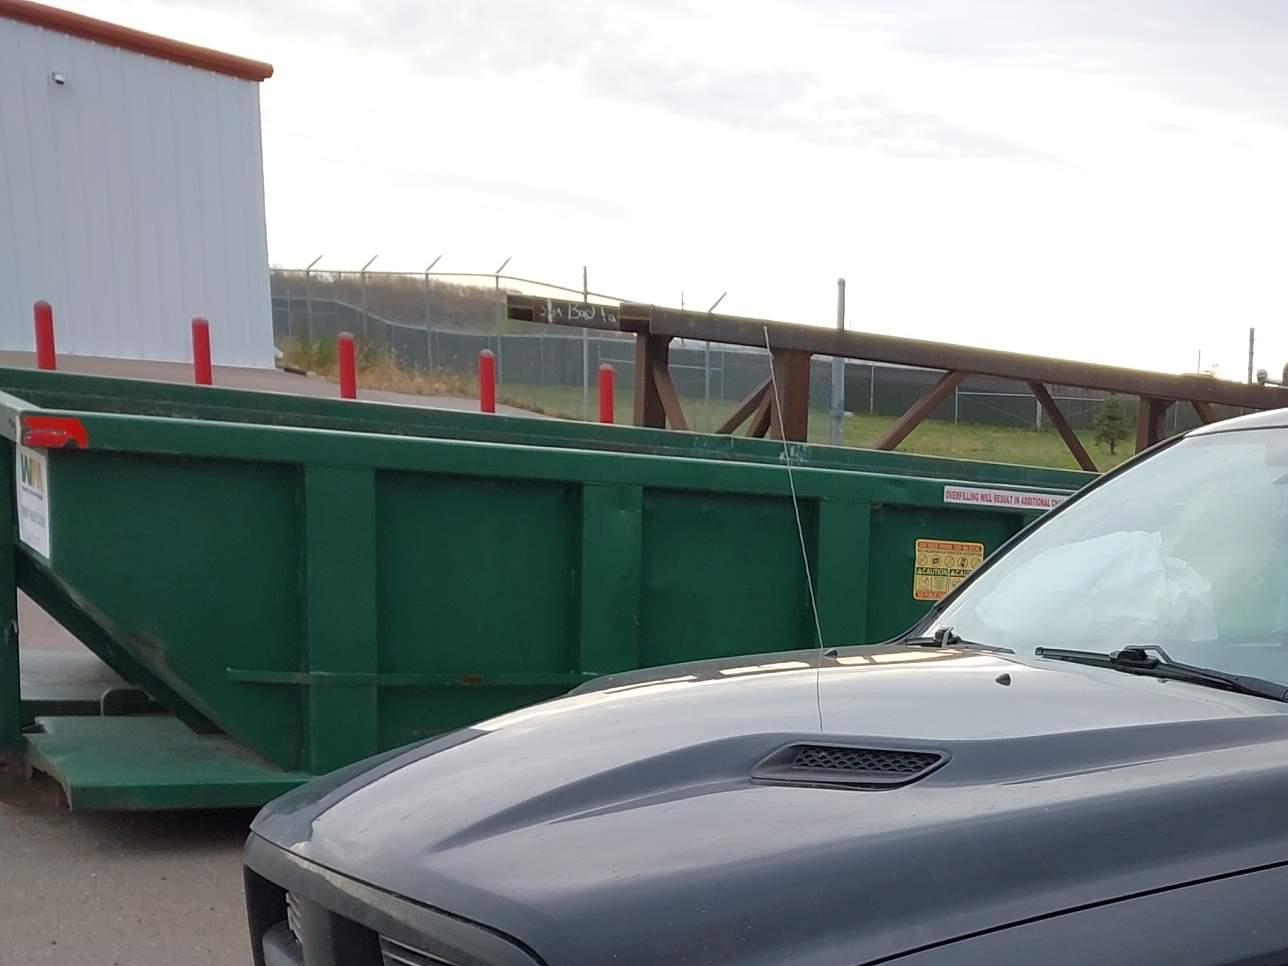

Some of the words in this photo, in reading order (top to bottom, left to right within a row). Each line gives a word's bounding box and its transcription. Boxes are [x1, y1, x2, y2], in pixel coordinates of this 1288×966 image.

[945, 490, 979, 501] OVERFILLING
[980, 492, 992, 502] WILL
[993, 494, 1013, 504] RESULT
[1015, 497, 1020, 505] IN
[1021, 497, 1050, 508] ADDITIONAL
[923, 568, 948, 576] CAUTION
